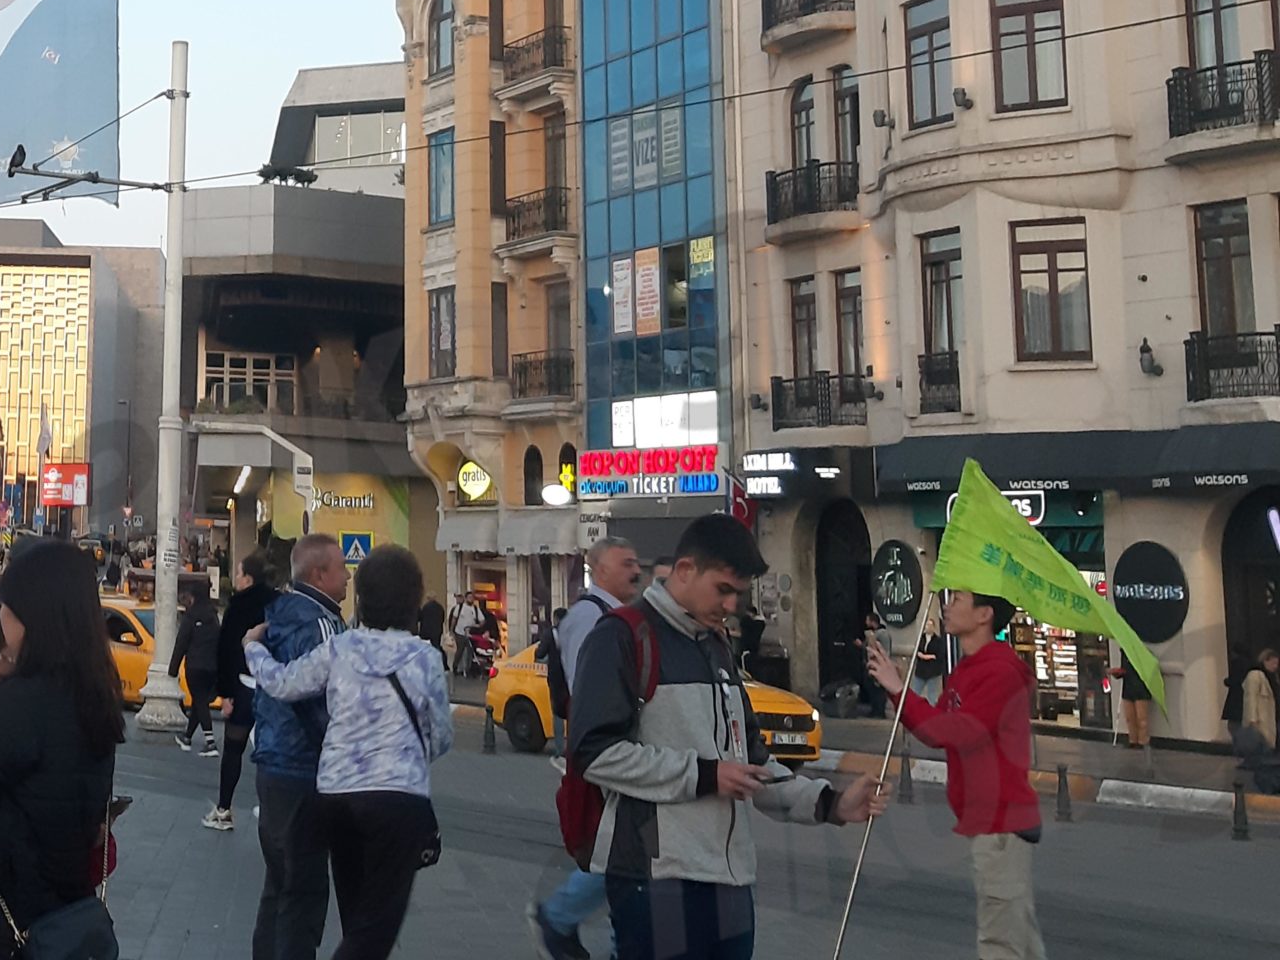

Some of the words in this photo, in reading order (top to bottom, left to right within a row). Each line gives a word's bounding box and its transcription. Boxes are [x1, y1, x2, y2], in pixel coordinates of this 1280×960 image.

[580, 451, 613, 477] HOP
[614, 450, 640, 476] ON
[642, 448, 679, 475] HOP
[680, 444, 718, 472] OFF
[462, 468, 487, 486] gratis
[1194, 474, 1249, 486] watsons
[907, 480, 941, 491] watsons
[1009, 480, 1069, 490] watsons
[322, 490, 374, 509] Garanti
